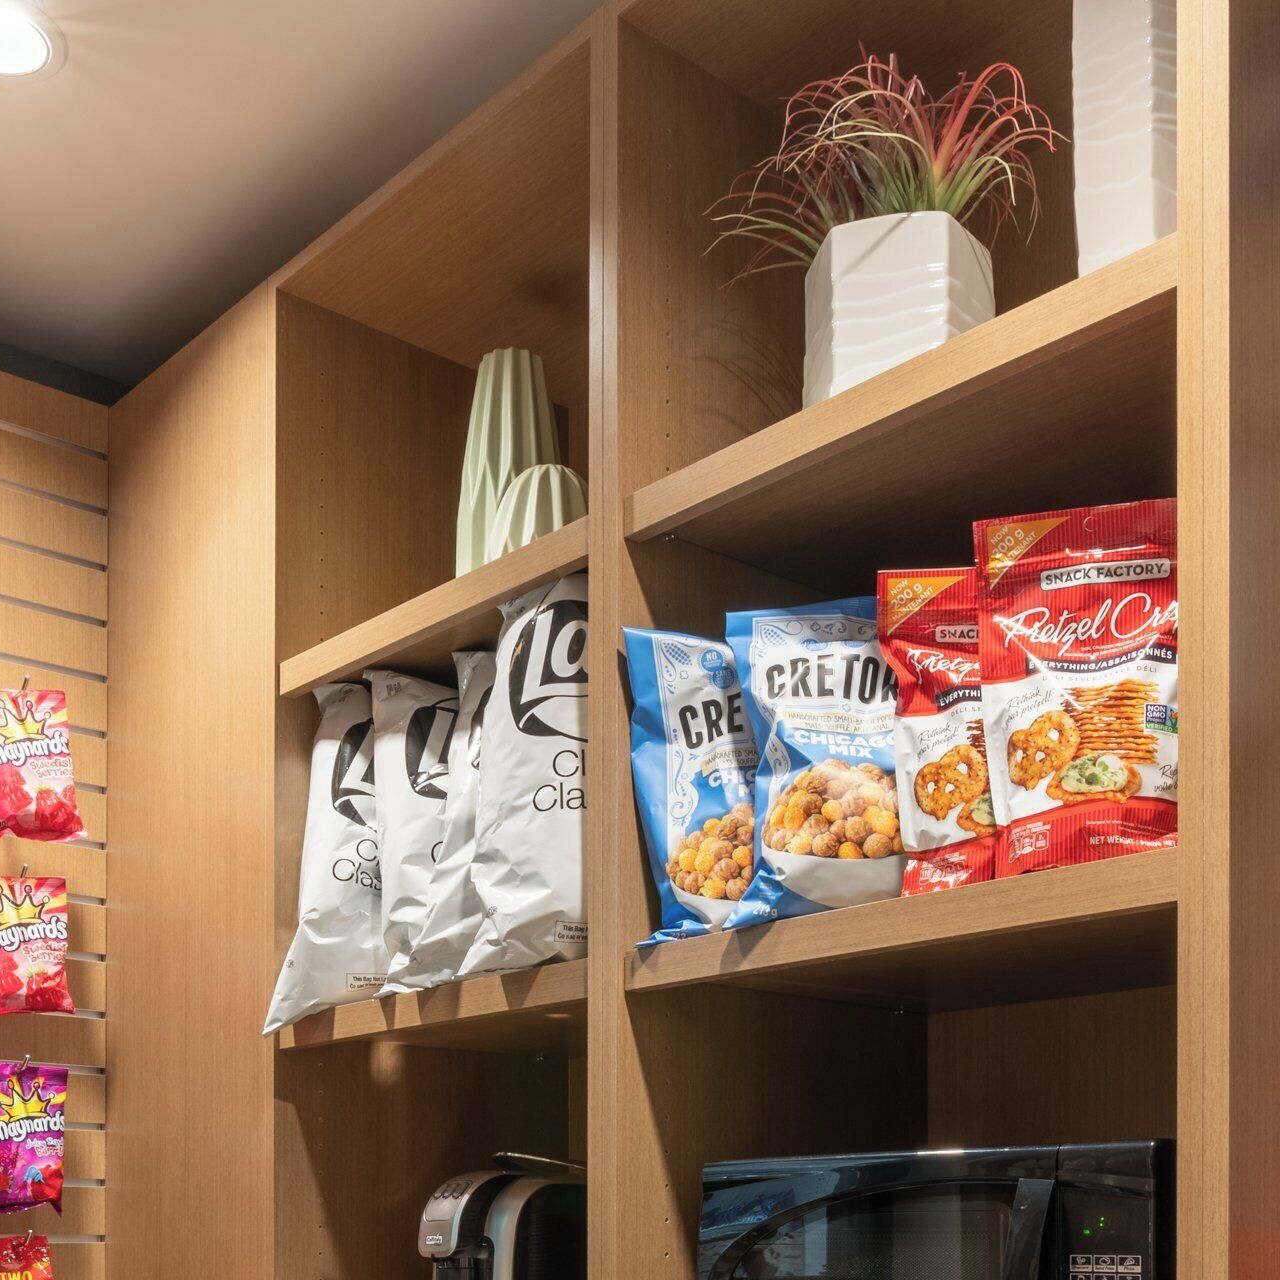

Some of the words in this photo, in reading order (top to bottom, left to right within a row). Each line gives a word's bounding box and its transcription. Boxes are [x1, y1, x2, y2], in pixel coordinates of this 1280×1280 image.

[1045, 567, 1091, 585] SNACK
[1096, 562, 1164, 579] FACTORY
[890, 578, 910, 597] NOW
[890, 588, 913, 609] 200
[1001, 598, 1113, 657] Pretzel
[1147, 704, 1166, 712] NON
[828, 744, 875, 760] MIX
[1089, 836, 1107, 846] NET
